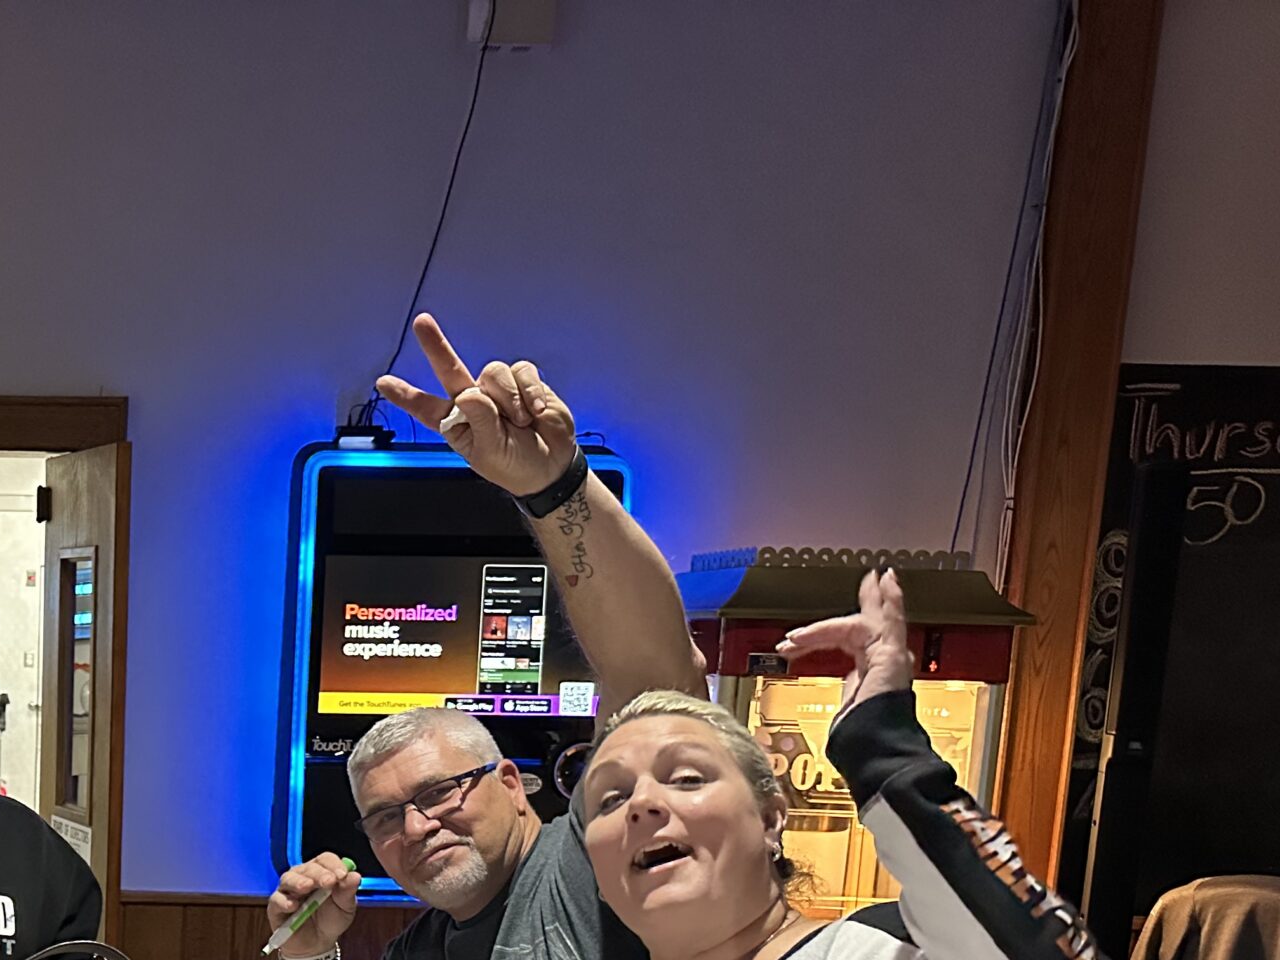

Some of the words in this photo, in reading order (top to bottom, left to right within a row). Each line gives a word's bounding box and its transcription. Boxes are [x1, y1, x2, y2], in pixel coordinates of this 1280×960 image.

[1120, 384, 1280, 462] Thurs
[344, 603, 458, 622] Personalized
[344, 621, 401, 639] music
[342, 639, 443, 660] experience
[338, 700, 352, 709] Get
[353, 700, 365, 708] the
